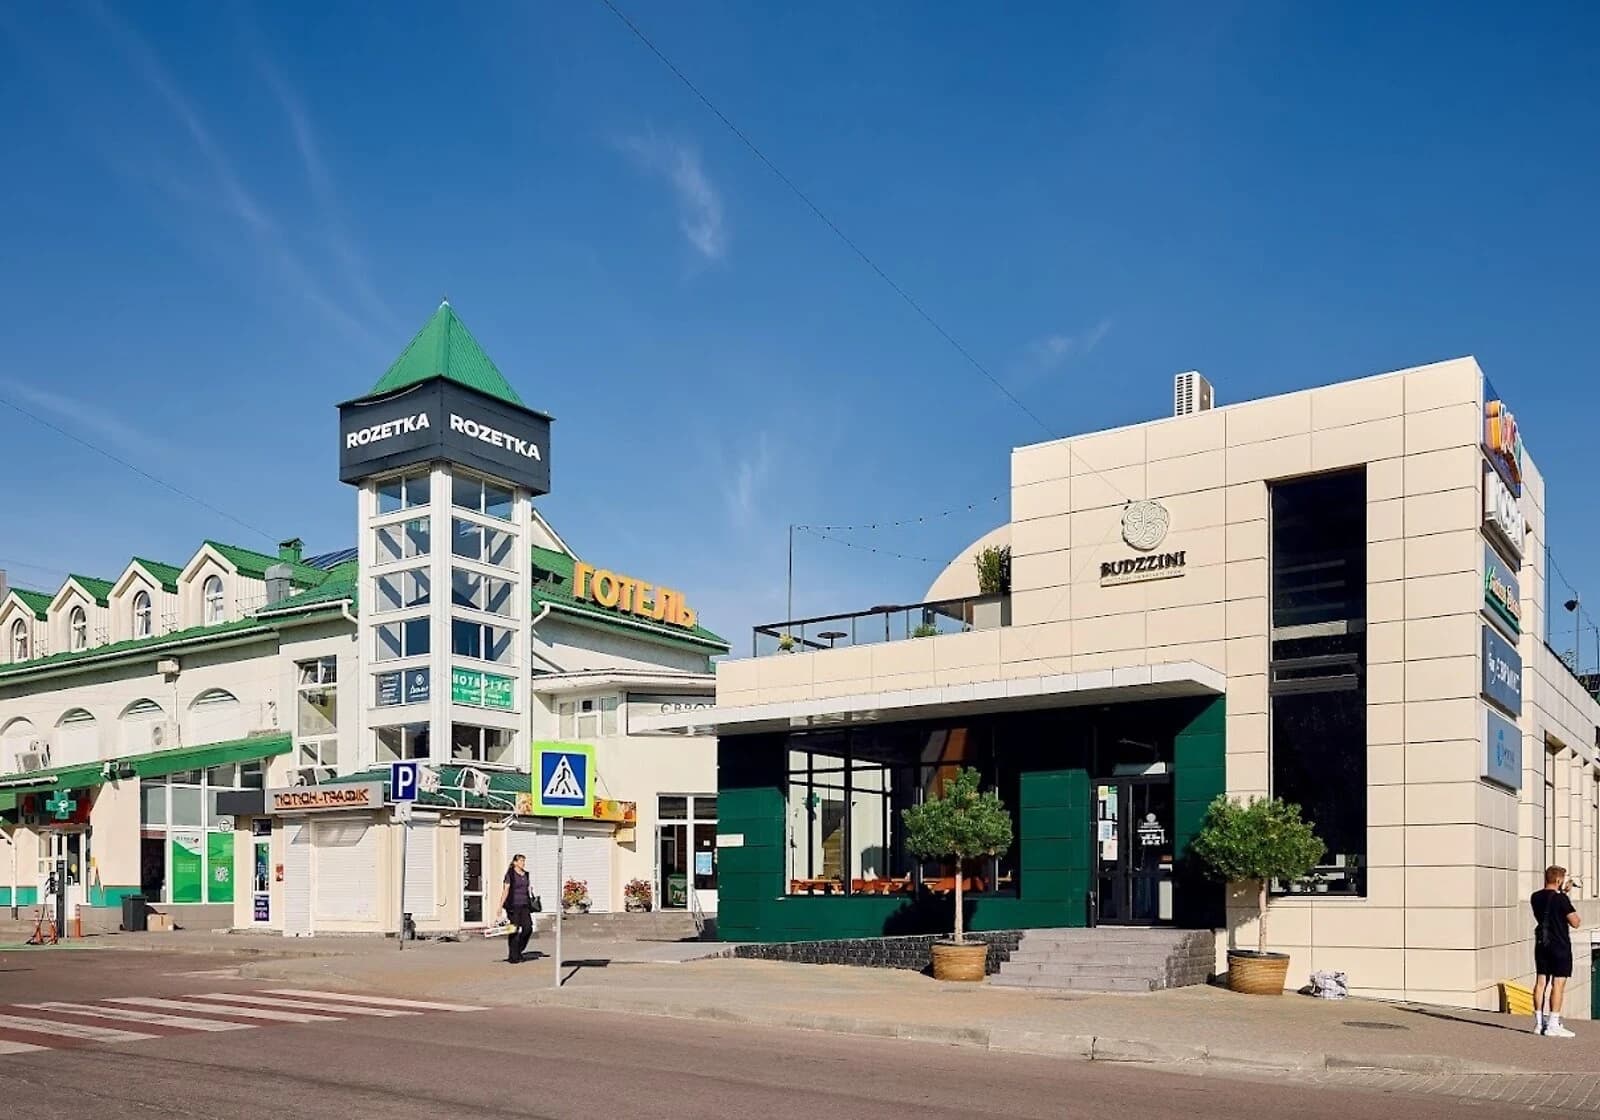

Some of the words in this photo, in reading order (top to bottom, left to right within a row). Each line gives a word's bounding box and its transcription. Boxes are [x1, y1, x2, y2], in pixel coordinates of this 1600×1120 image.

[346, 412, 431, 448] ROZETKA
[450, 412, 542, 461] ROZETKA
[1100, 550, 1187, 578] BUDZZINI
[573, 561, 697, 629] ГОТЕЛЬ
[398, 765, 414, 798] P
